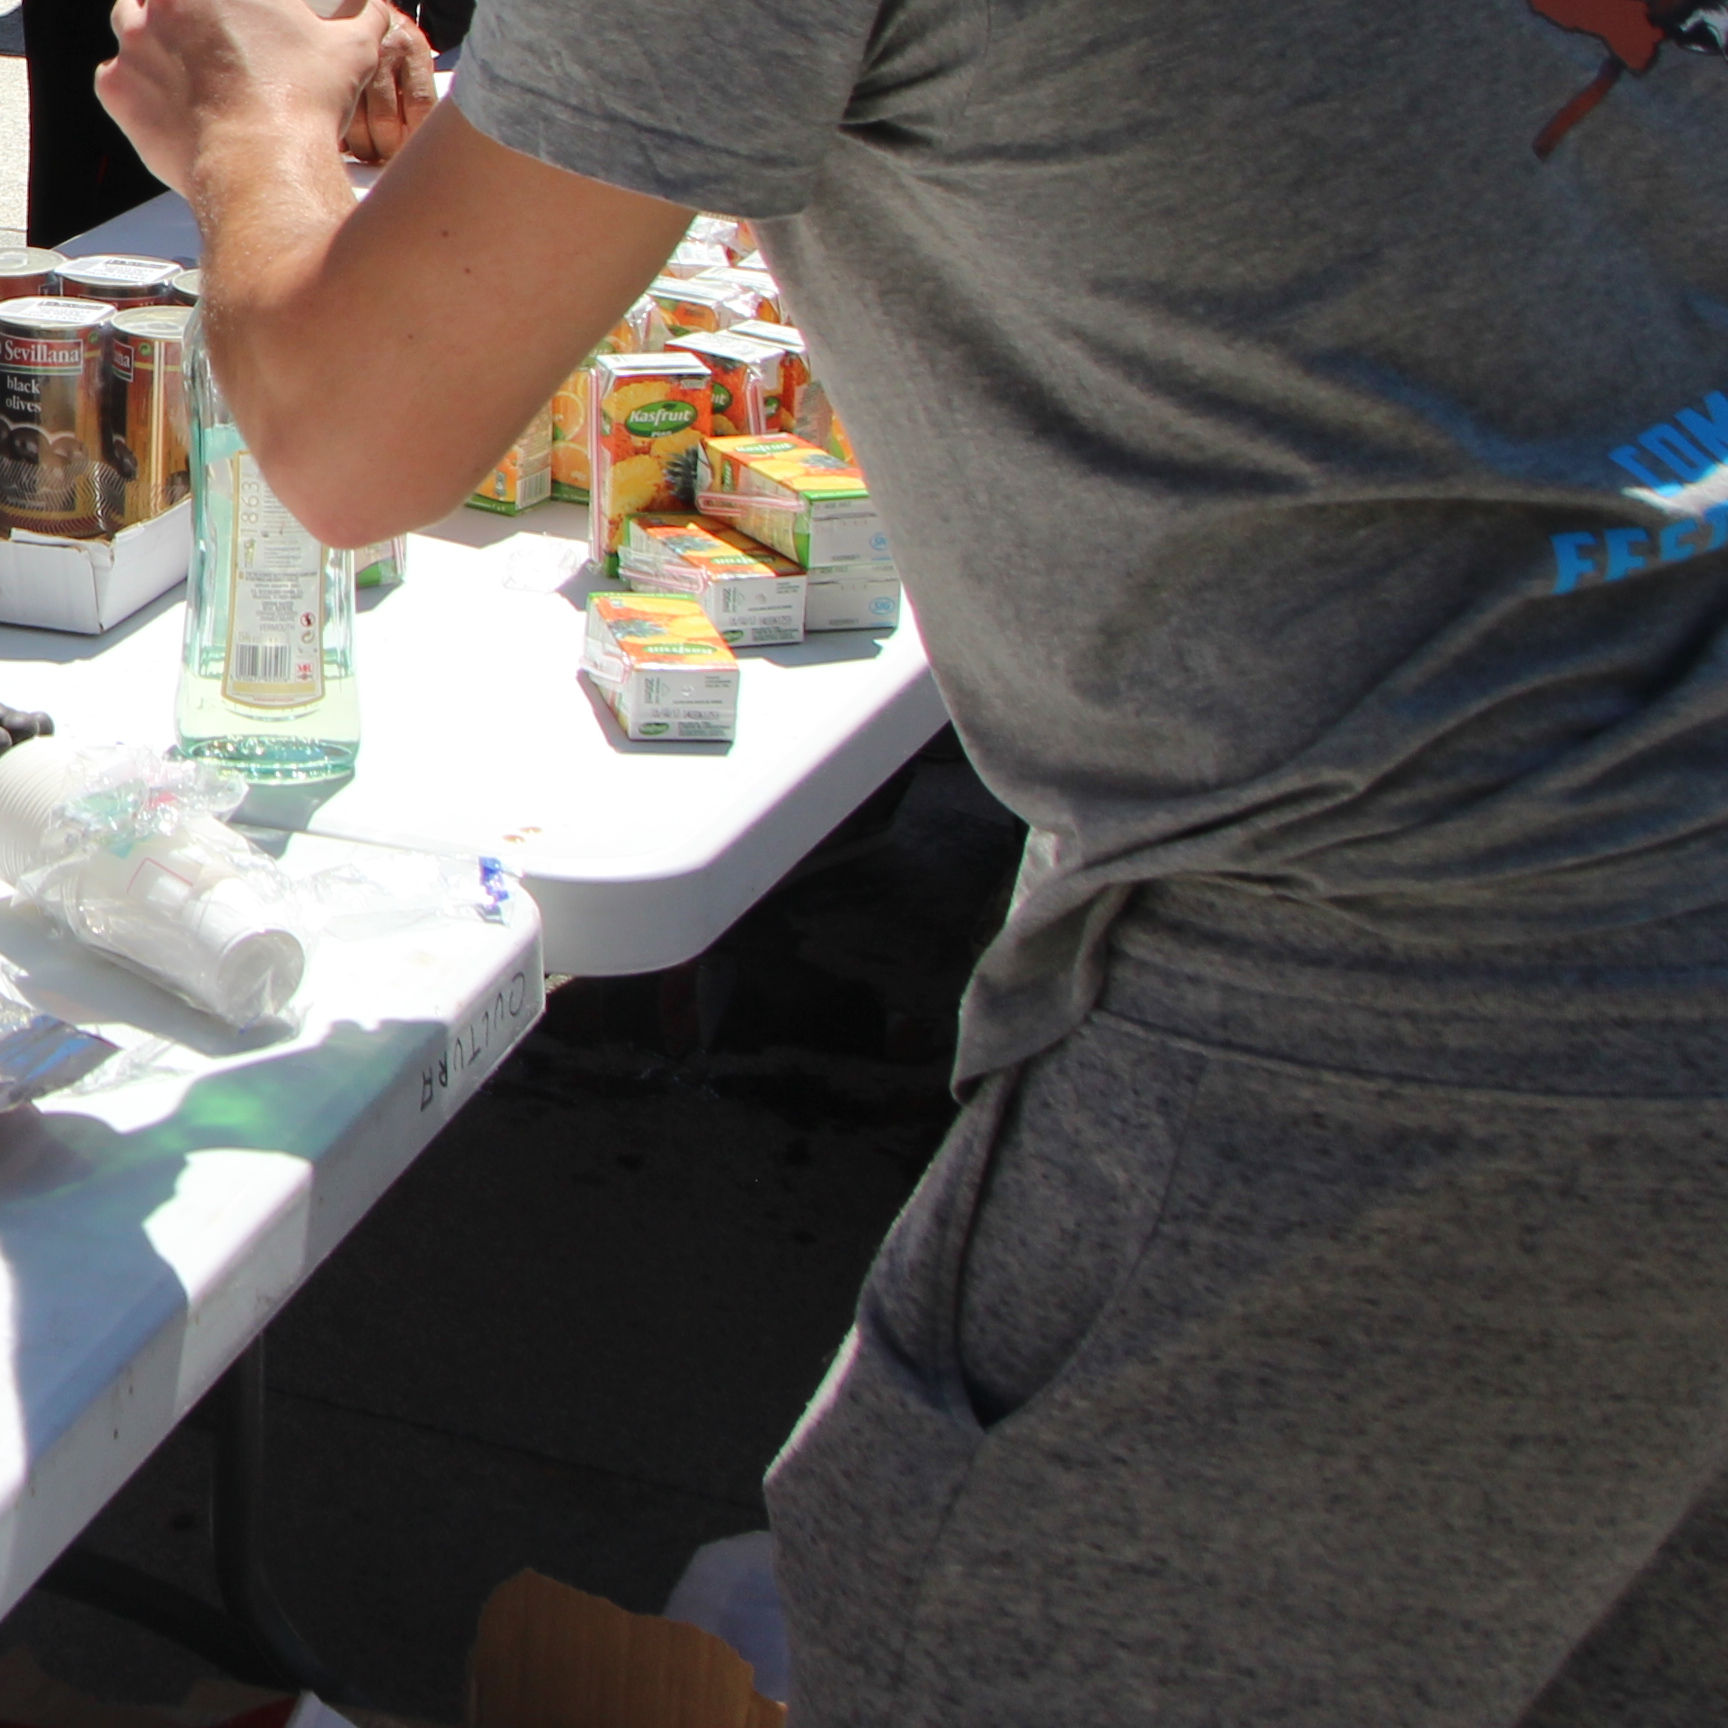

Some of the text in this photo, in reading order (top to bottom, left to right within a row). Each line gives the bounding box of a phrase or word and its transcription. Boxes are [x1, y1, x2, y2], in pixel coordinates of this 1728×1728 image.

[4, 339, 81, 365] Sevillana
[7, 375, 41, 395] black
[5, 396, 42, 413] olives
[630, 409, 694, 427] Kasfruit
[420, 971, 526, 1112] CULTURA
